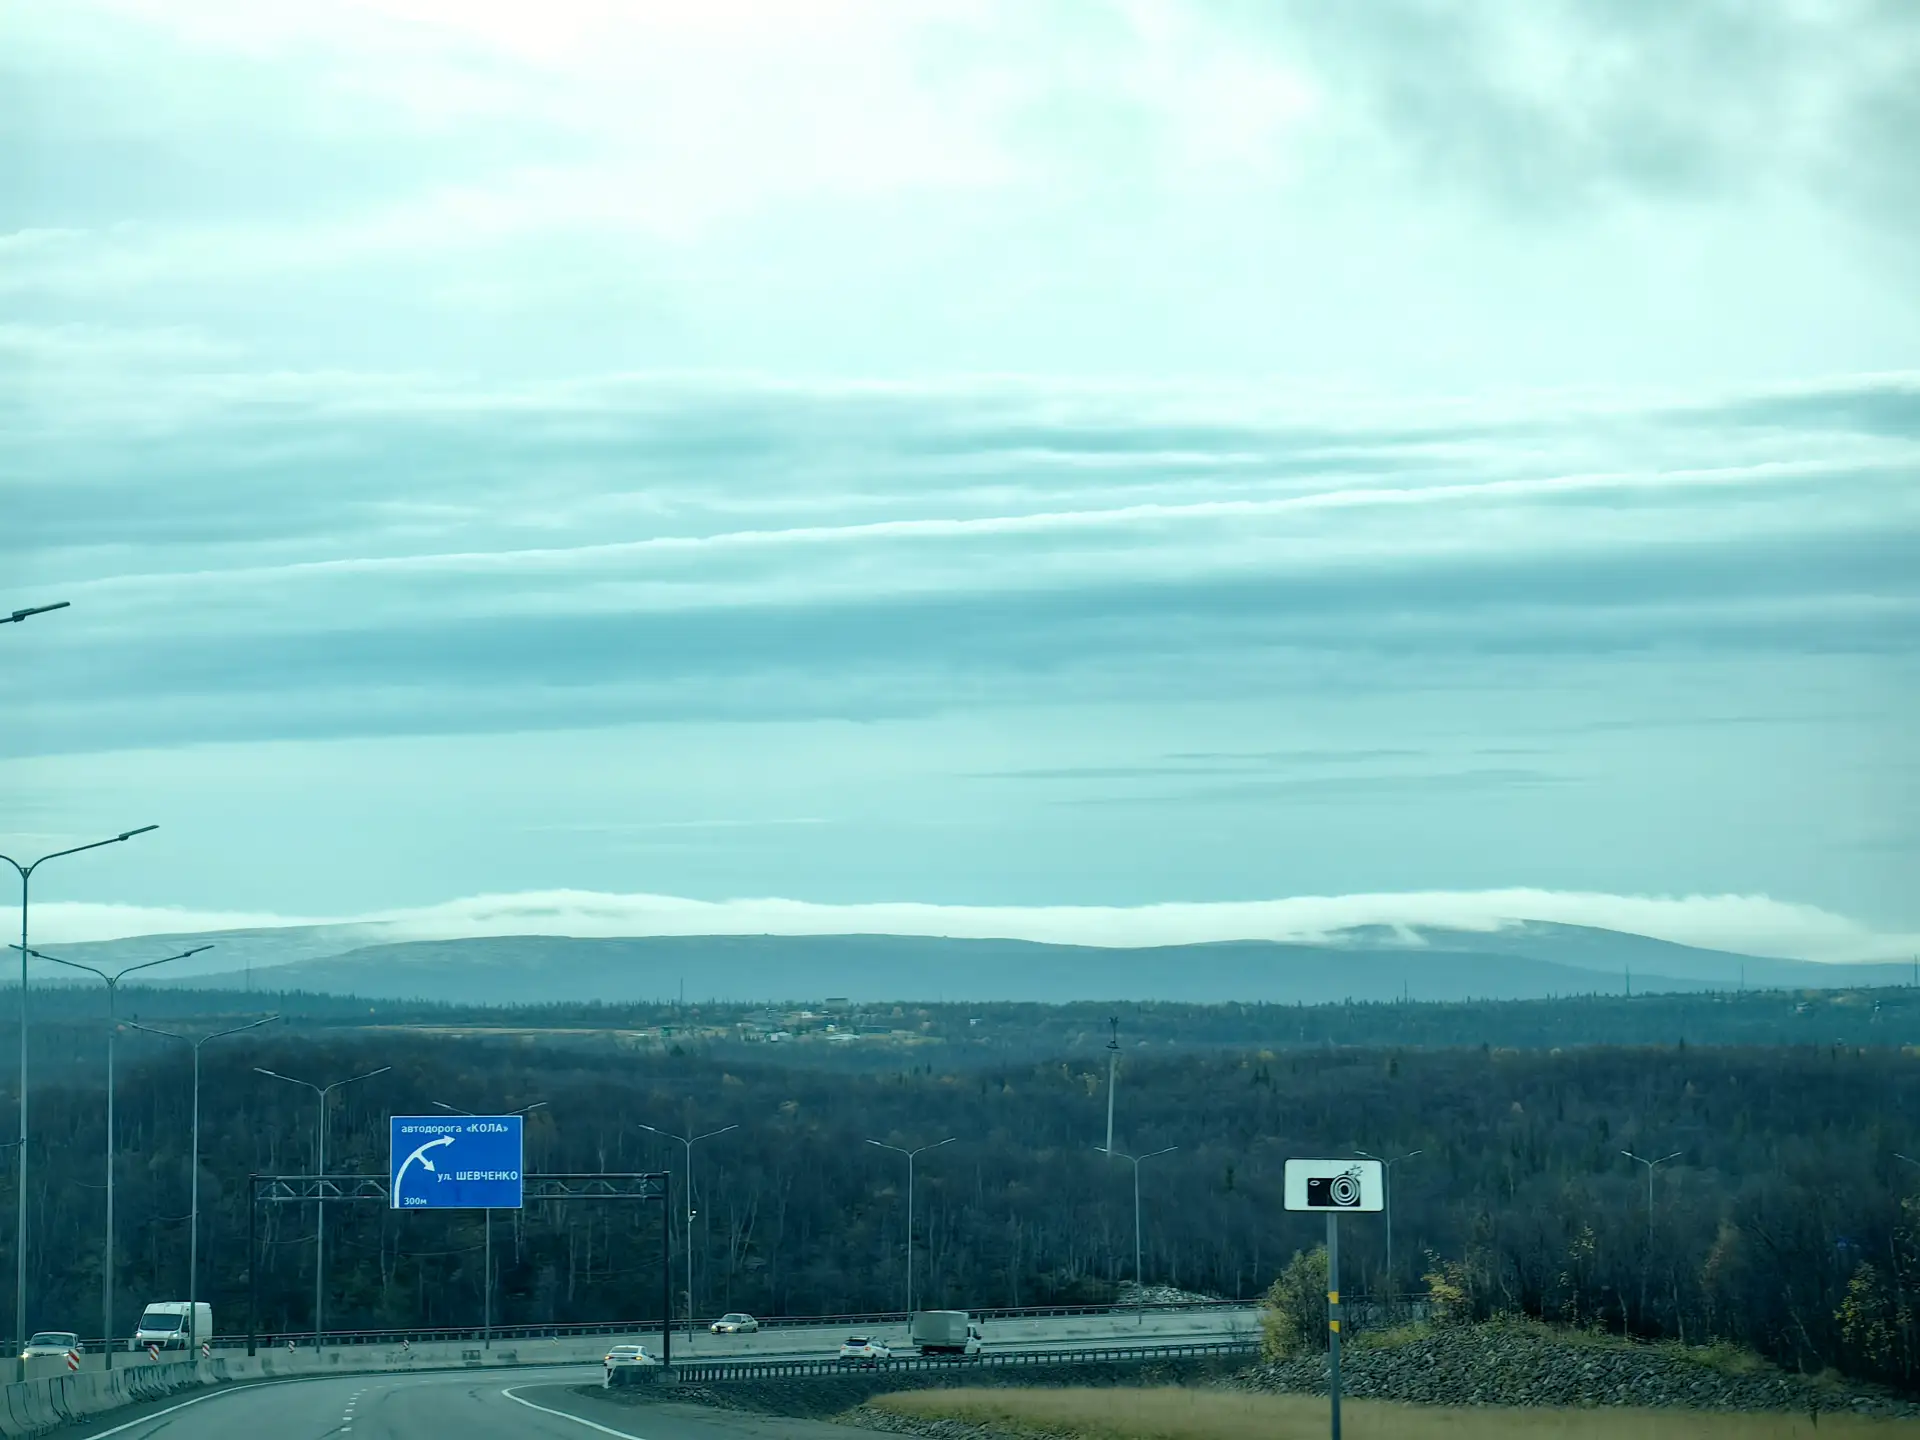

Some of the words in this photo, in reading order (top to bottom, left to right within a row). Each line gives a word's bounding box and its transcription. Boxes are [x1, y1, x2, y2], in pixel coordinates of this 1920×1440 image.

[401, 1125, 462, 1135] автодорога
[466, 1123, 509, 1132] «КОЛА»
[437, 1173, 452, 1182] ул.
[456, 1171, 518, 1180] ШЕВЧЕНКО
[404, 1197, 427, 1205] 300м
